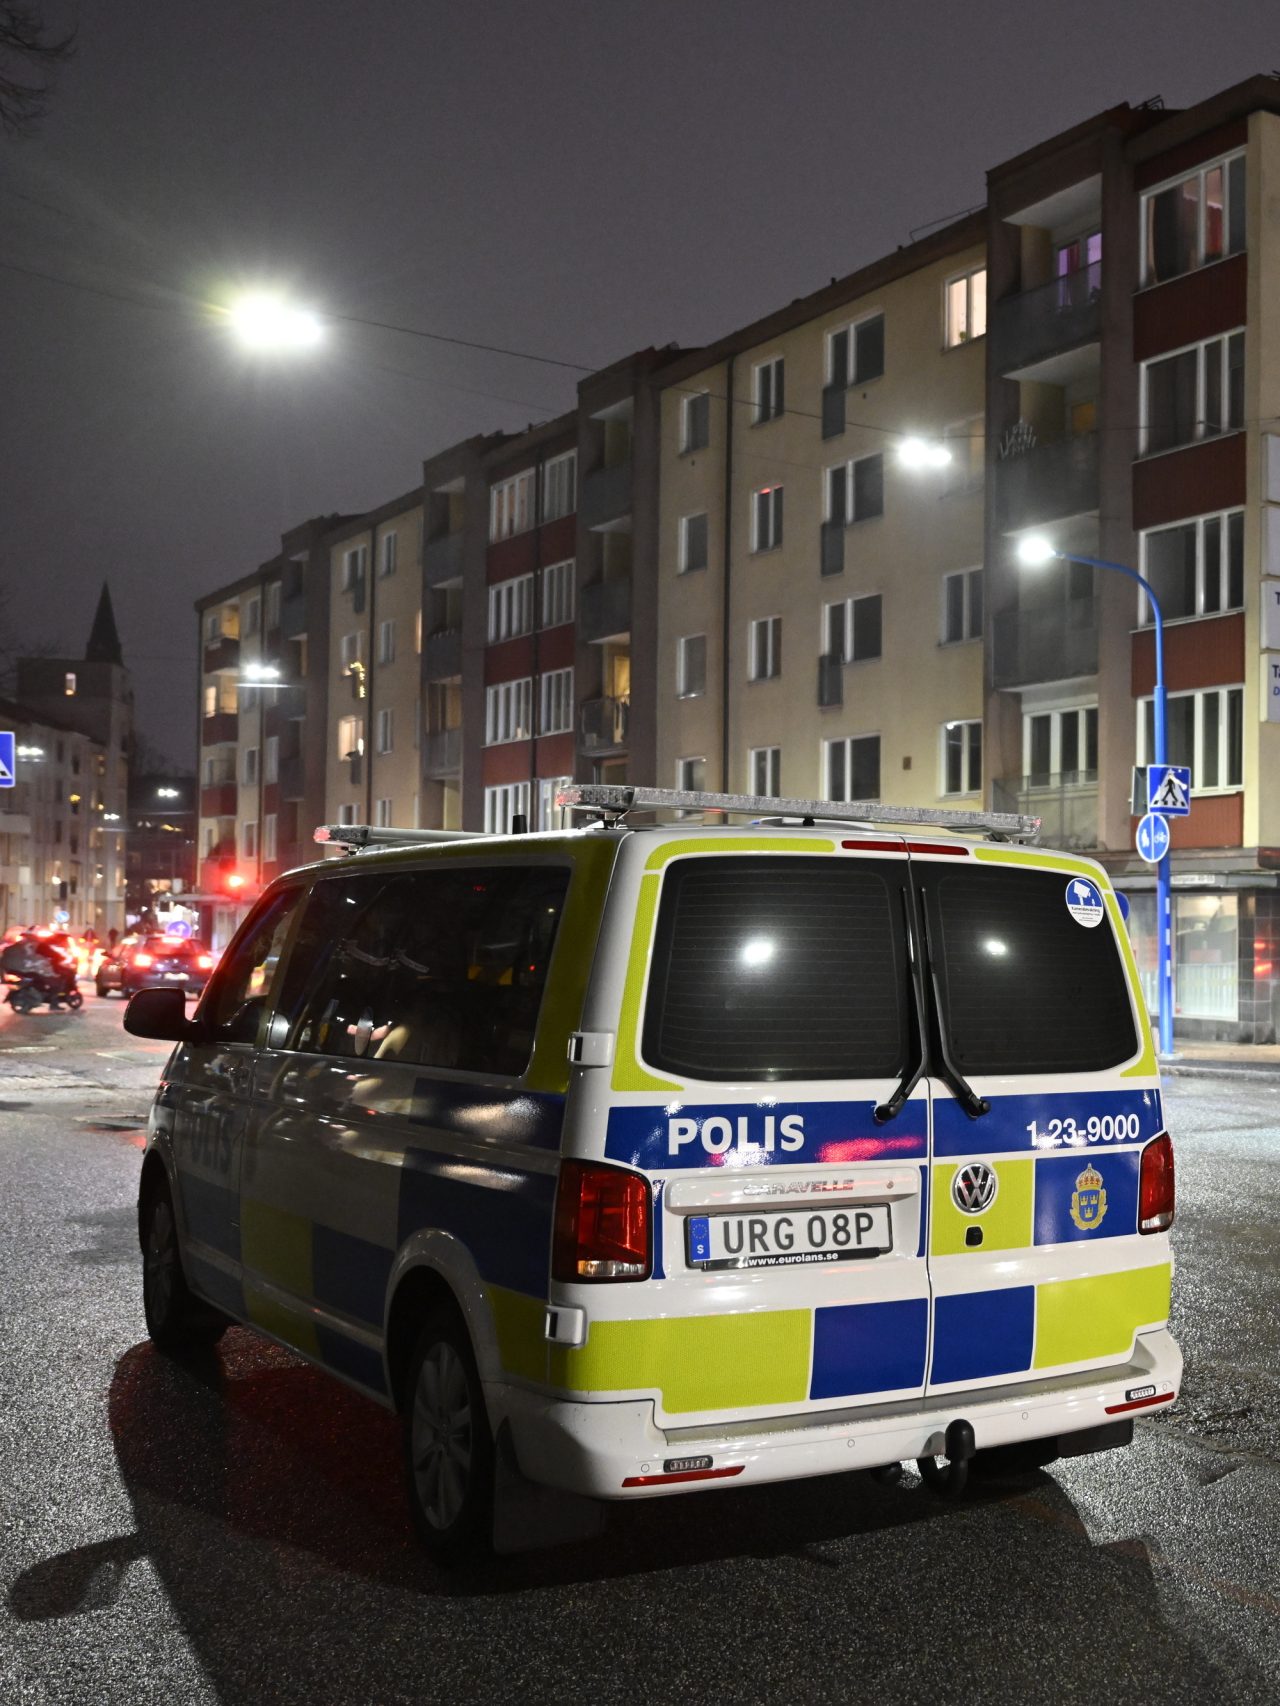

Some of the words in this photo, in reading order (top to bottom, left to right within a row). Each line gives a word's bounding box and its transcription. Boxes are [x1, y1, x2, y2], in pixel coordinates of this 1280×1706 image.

[668, 1114, 806, 1156] POLIS
[1026, 1113, 1140, 1147] 123-9000
[743, 1179, 854, 1196] CARAVELLE
[697, 1244, 706, 1256] S
[723, 1216, 795, 1255] URG
[807, 1212, 875, 1248] 08P
[748, 1252, 839, 1266] www.eurolans.se
